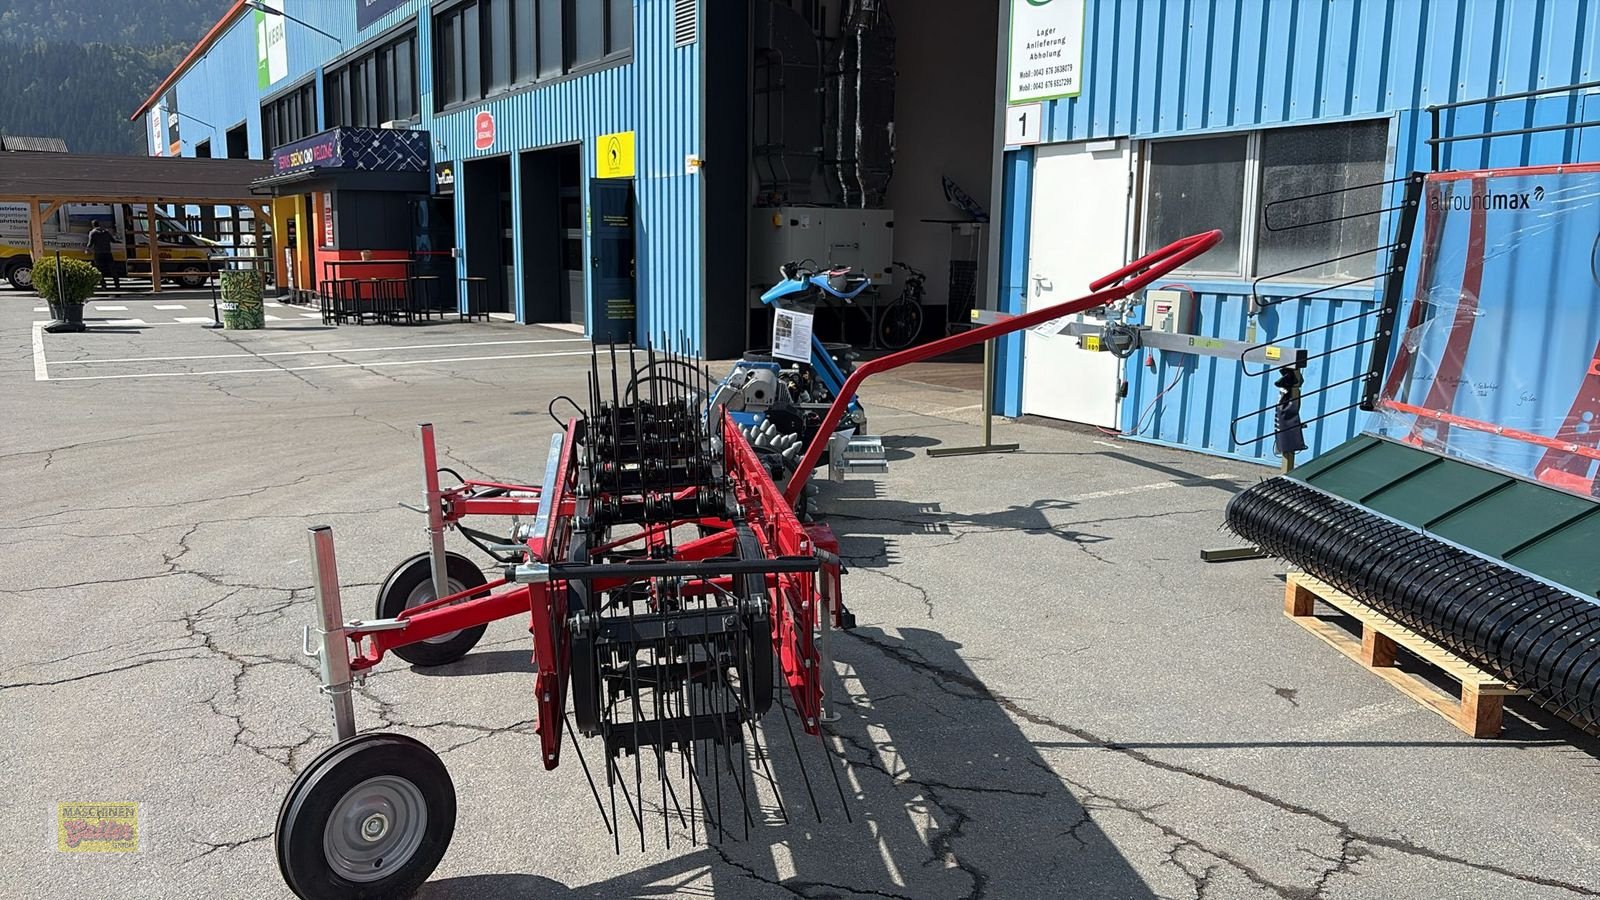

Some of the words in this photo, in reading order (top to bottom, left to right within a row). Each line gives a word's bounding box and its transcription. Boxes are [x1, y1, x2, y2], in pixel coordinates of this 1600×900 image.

[1036, 28, 1056, 37] Lager
[1026, 37, 1066, 50] Anlieferung
[1029, 49, 1062, 61] Abholung
[1019, 112, 1027, 137] 1
[1431, 188, 1530, 212] allroundmax
